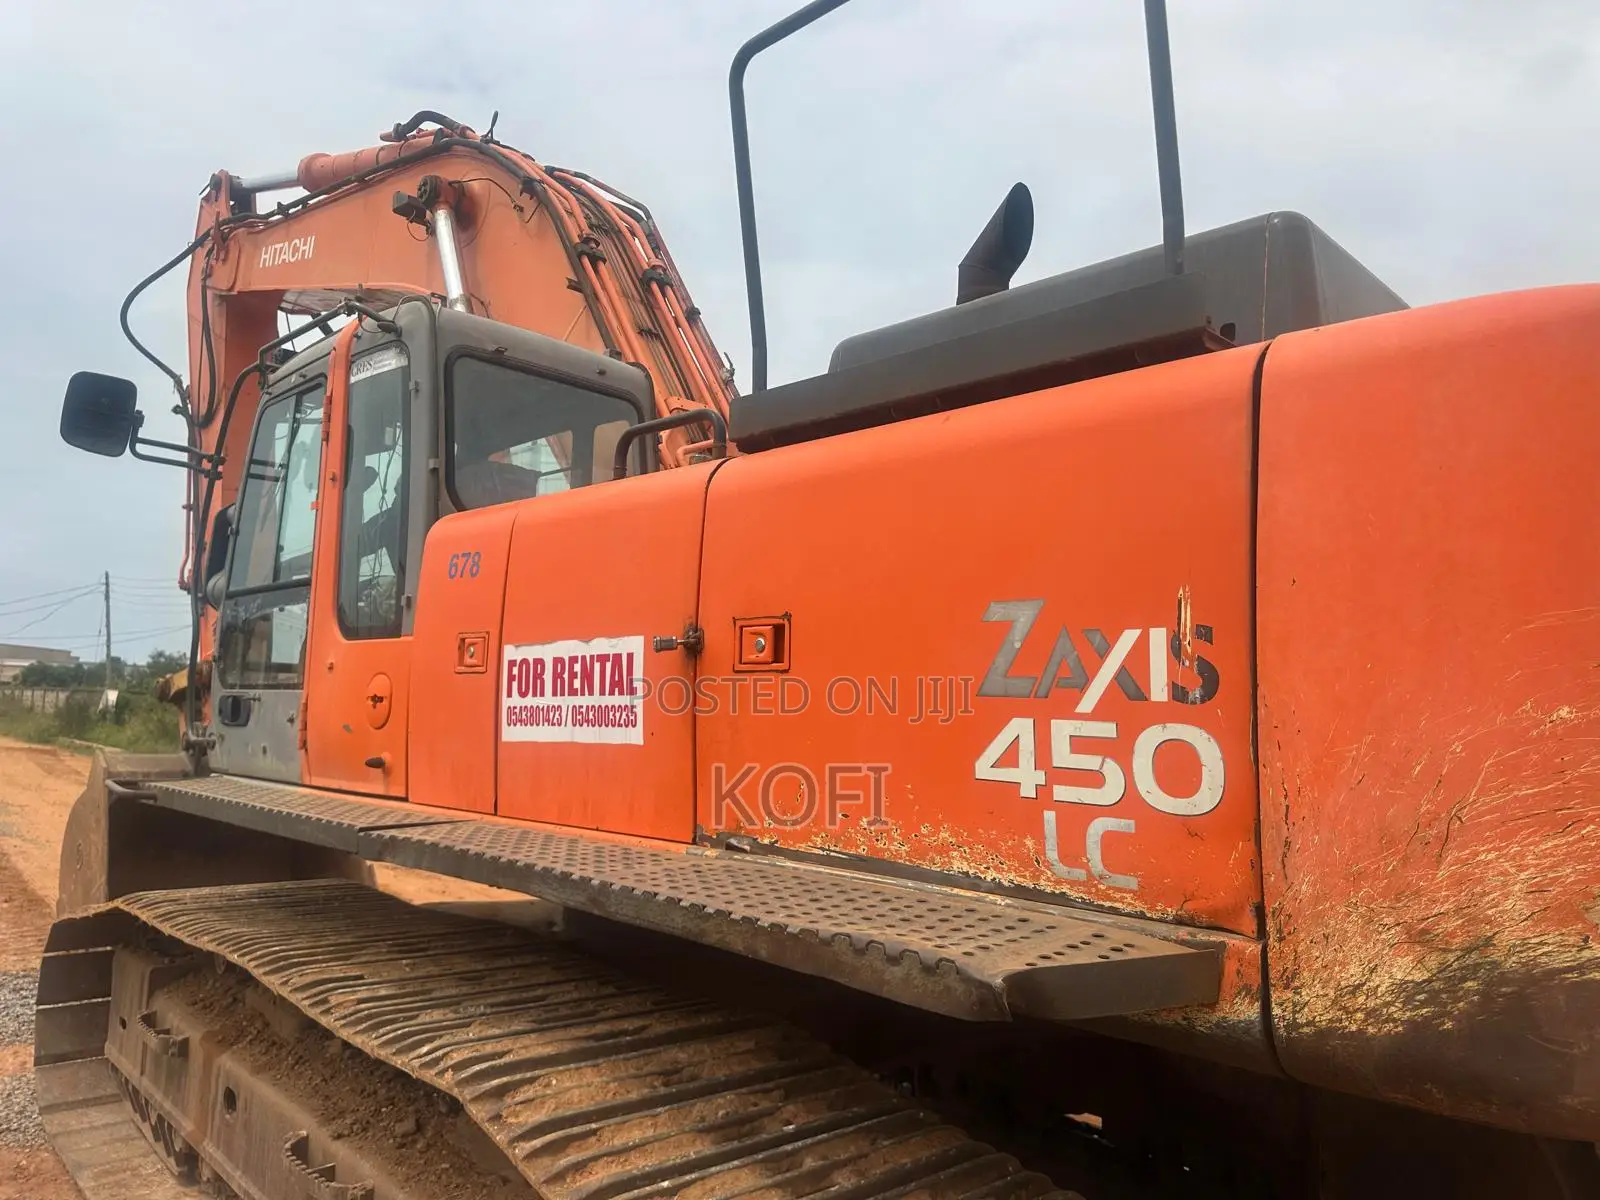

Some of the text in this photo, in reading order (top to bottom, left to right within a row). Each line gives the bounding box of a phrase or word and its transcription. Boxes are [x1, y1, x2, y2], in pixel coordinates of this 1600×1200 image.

[259, 235, 315, 268] HITACHI
[448, 551, 481, 579] 678
[506, 652, 638, 699] FOR RENTAL
[976, 598, 1220, 714] ZAXIS
[506, 703, 638, 729] 0543801423 / 0543003235
[975, 717, 1226, 817] 450
[1043, 810, 1139, 891] LC
